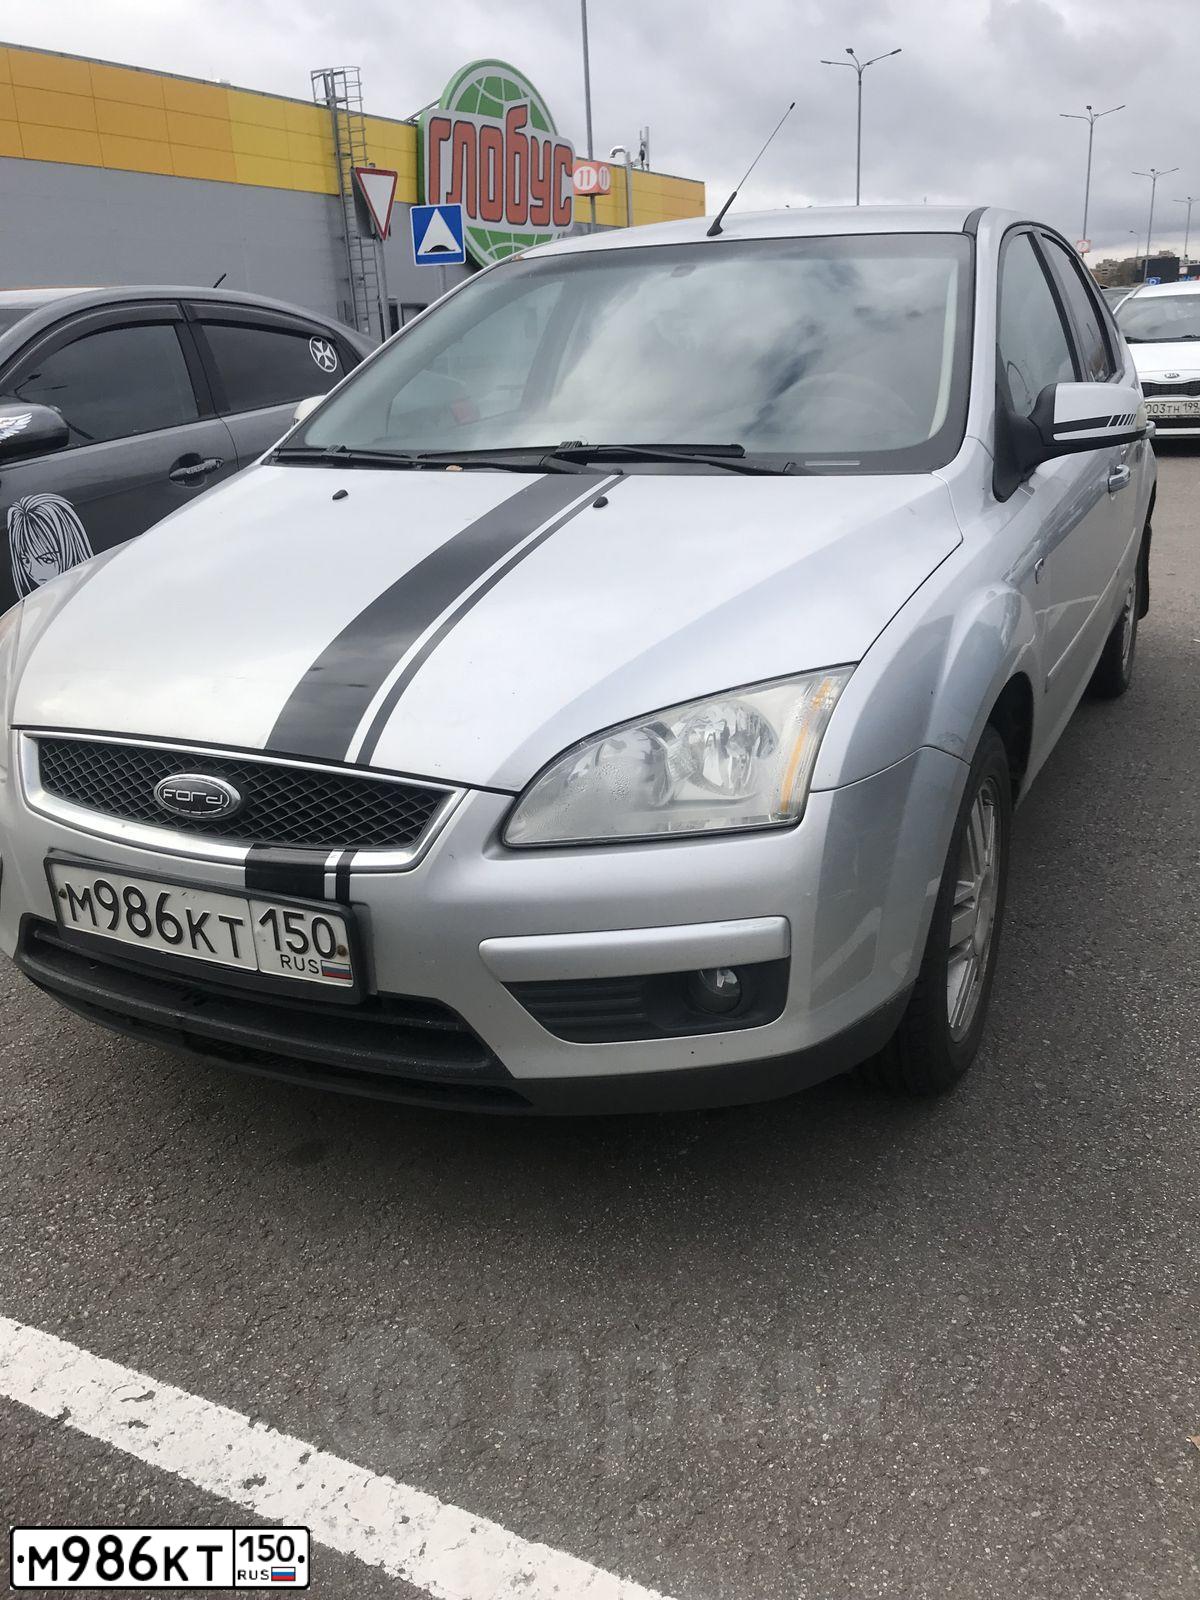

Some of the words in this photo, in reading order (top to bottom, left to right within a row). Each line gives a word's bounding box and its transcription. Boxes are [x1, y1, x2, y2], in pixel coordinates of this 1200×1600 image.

[64, 879, 244, 958] М986КТ
[258, 908, 337, 959] 150
[279, 954, 320, 974] RUS
